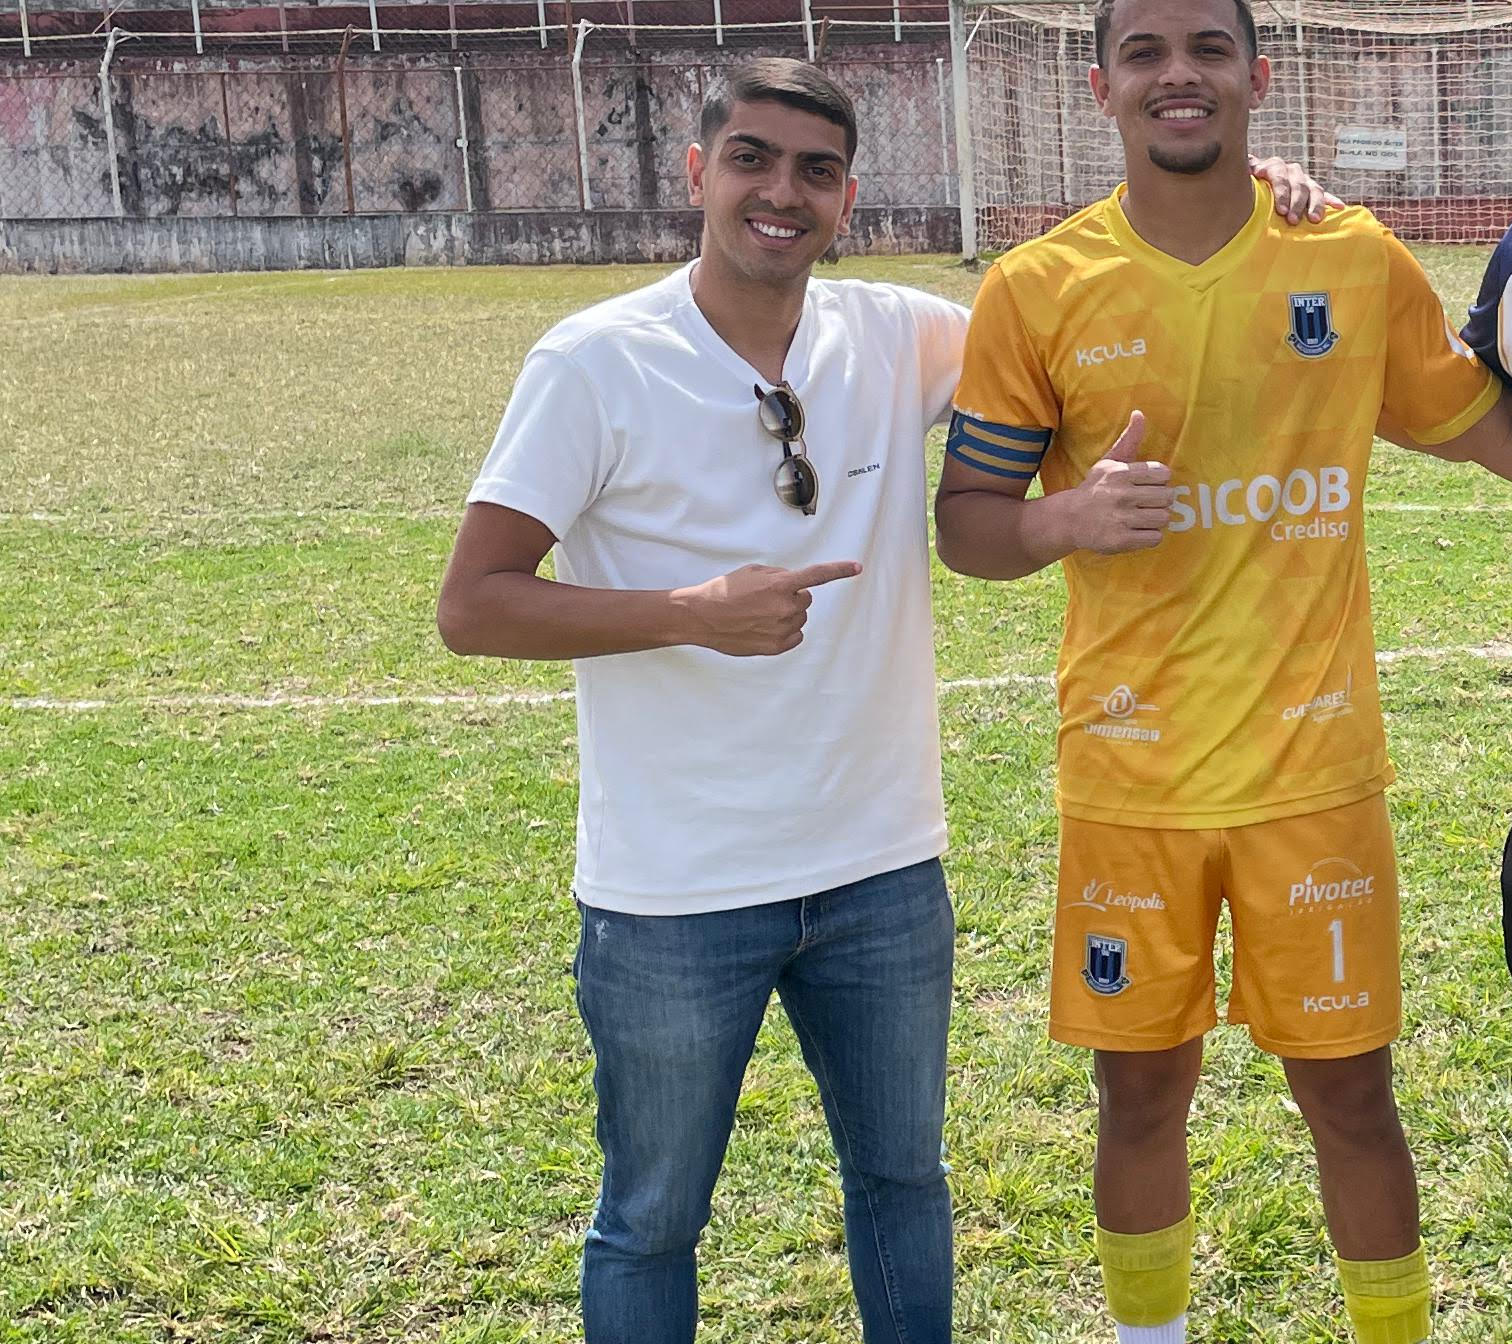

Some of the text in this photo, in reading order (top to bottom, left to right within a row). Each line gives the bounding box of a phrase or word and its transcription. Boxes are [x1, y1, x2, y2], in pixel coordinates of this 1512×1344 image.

[1293, 296, 1326, 308] INTER
[1168, 466, 1351, 533] SICOOB
[1288, 873, 1375, 906] Pivotec
[1328, 919, 1345, 982] 1
